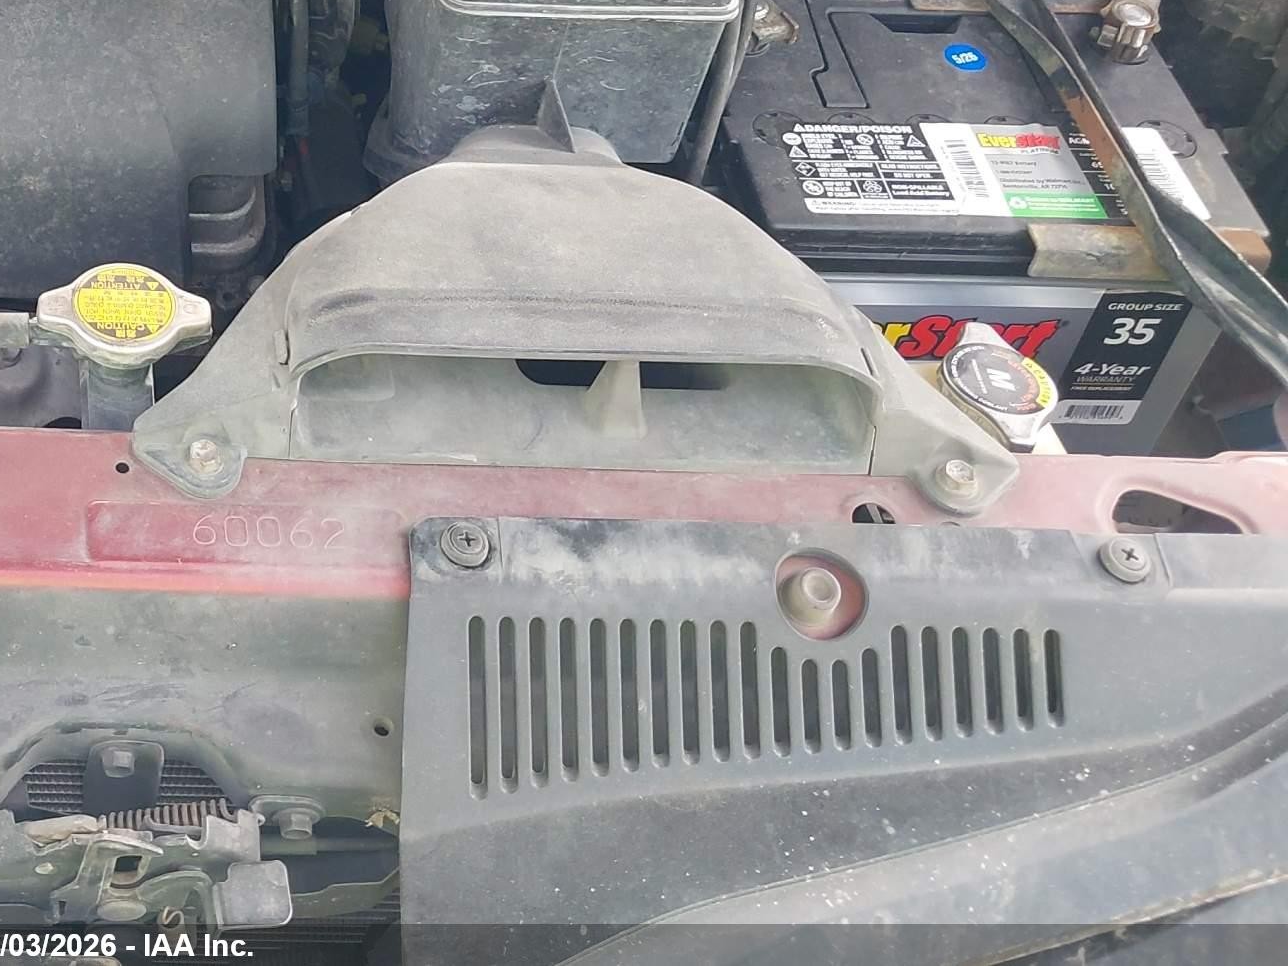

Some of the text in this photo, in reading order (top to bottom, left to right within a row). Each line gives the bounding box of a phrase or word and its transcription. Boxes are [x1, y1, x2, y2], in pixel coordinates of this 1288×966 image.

[804, 124, 913, 134] DANGER/POISON
[90, 281, 141, 291] ATTENTION
[1107, 302, 1184, 311] GROUP SIZE
[96, 322, 145, 331] CAUTION
[1103, 317, 1163, 345] 35
[1073, 363, 1152, 376] 4-Year
[1076, 375, 1134, 383] WARRANTY
[192, 513, 346, 549] 60062
